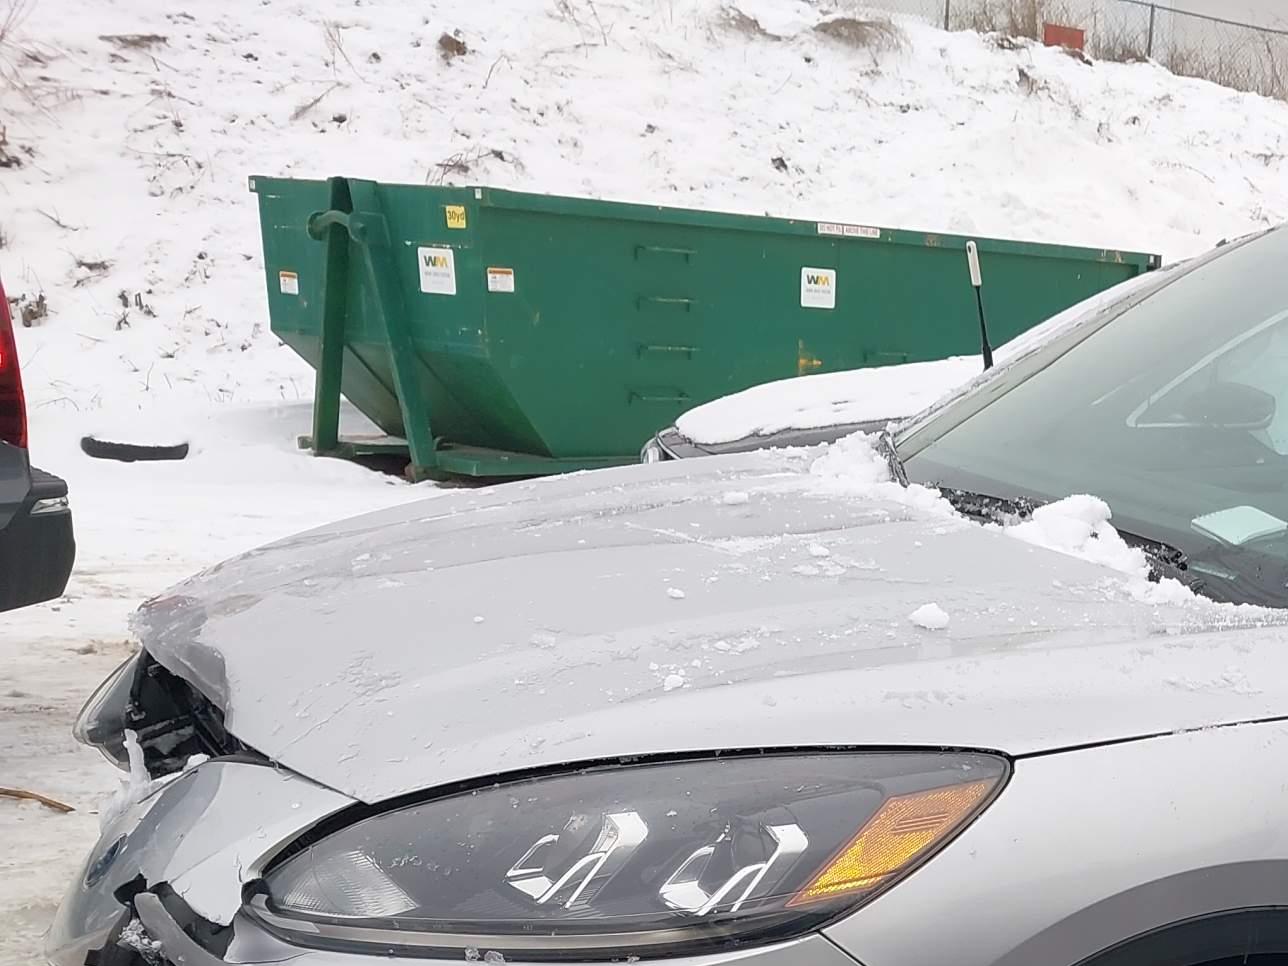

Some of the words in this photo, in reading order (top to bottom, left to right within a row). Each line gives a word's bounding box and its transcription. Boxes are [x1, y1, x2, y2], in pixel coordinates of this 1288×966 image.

[448, 210, 464, 223] 30yd
[424, 255, 448, 268] WM
[807, 274, 830, 286] WM
